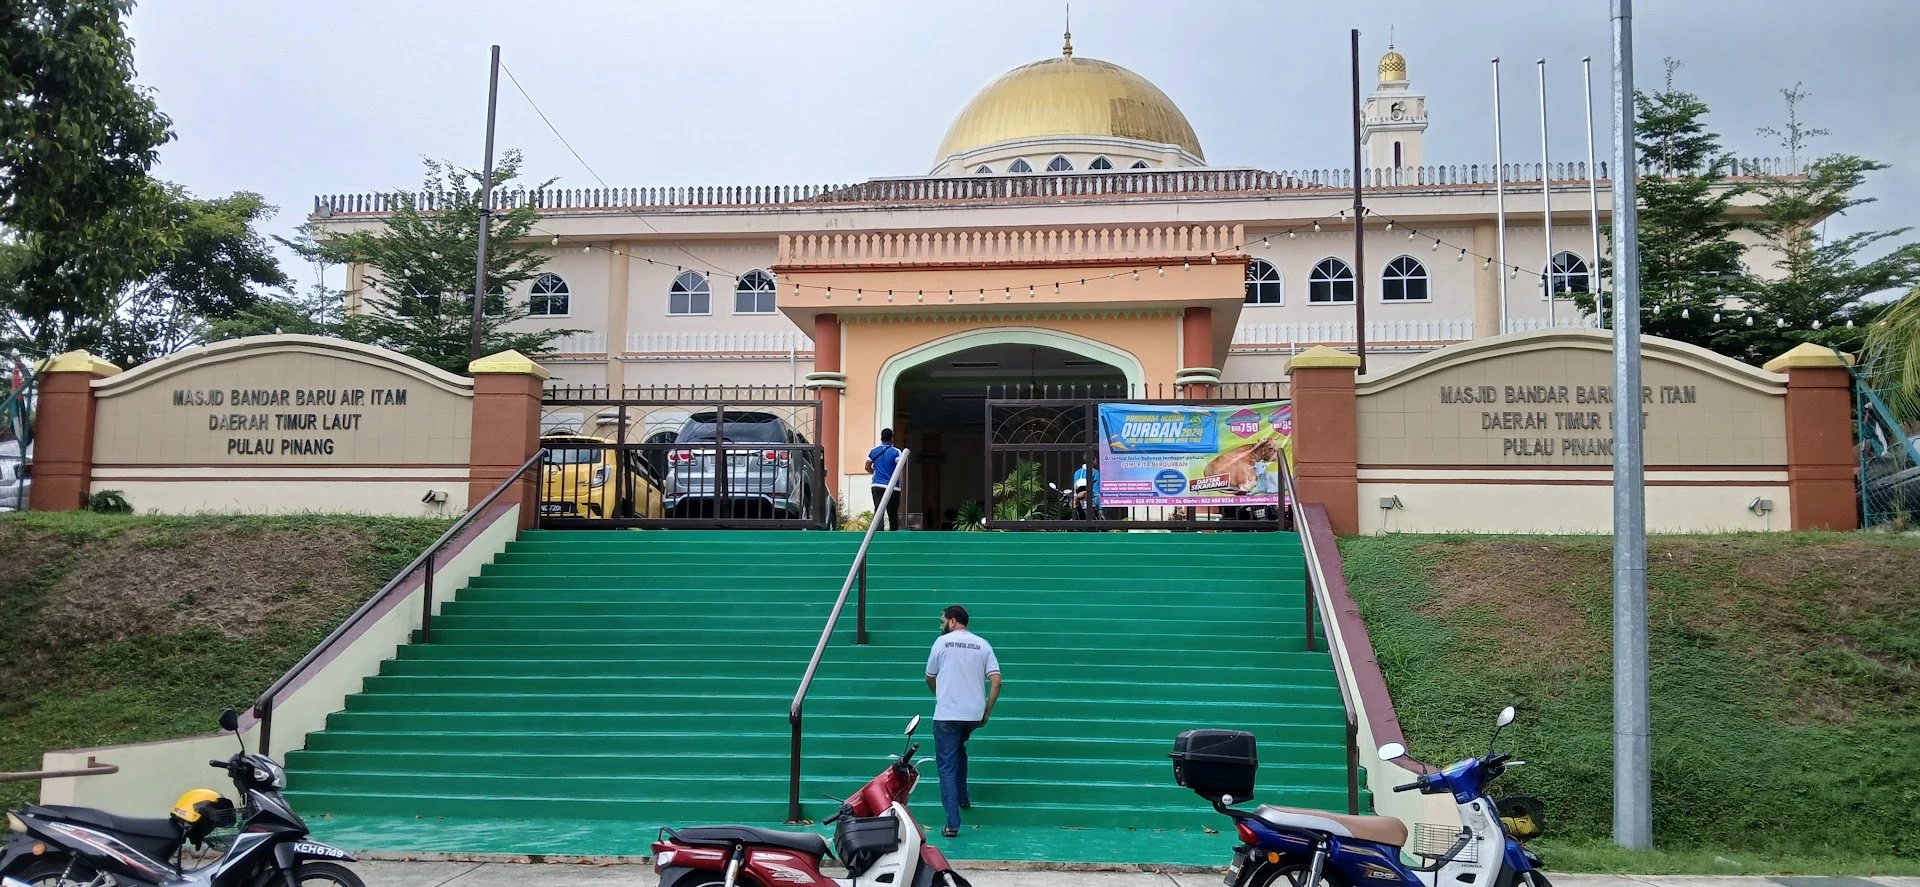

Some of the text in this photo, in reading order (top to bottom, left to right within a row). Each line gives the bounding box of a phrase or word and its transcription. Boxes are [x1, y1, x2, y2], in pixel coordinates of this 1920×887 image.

[173, 389, 407, 406] MASJID BANDAR BARU AIR ITAM
[1440, 386, 1497, 403] MASJID
[1505, 386, 1569, 403] BANDAR
[1660, 386, 1696, 403] ITAM
[209, 414, 362, 430] DAERAH TIMUR LAUT
[1482, 412, 1547, 429] DAERAH
[1555, 412, 1601, 429] TIMUR
[1122, 422, 1203, 439] QURBAN 2024
[228, 439, 334, 455] PULAU PINANG
[1503, 438, 1554, 455] PULAU
[1191, 477, 1228, 491] DAFTAR SEKARANG!
[293, 842, 344, 858] KEH6749
